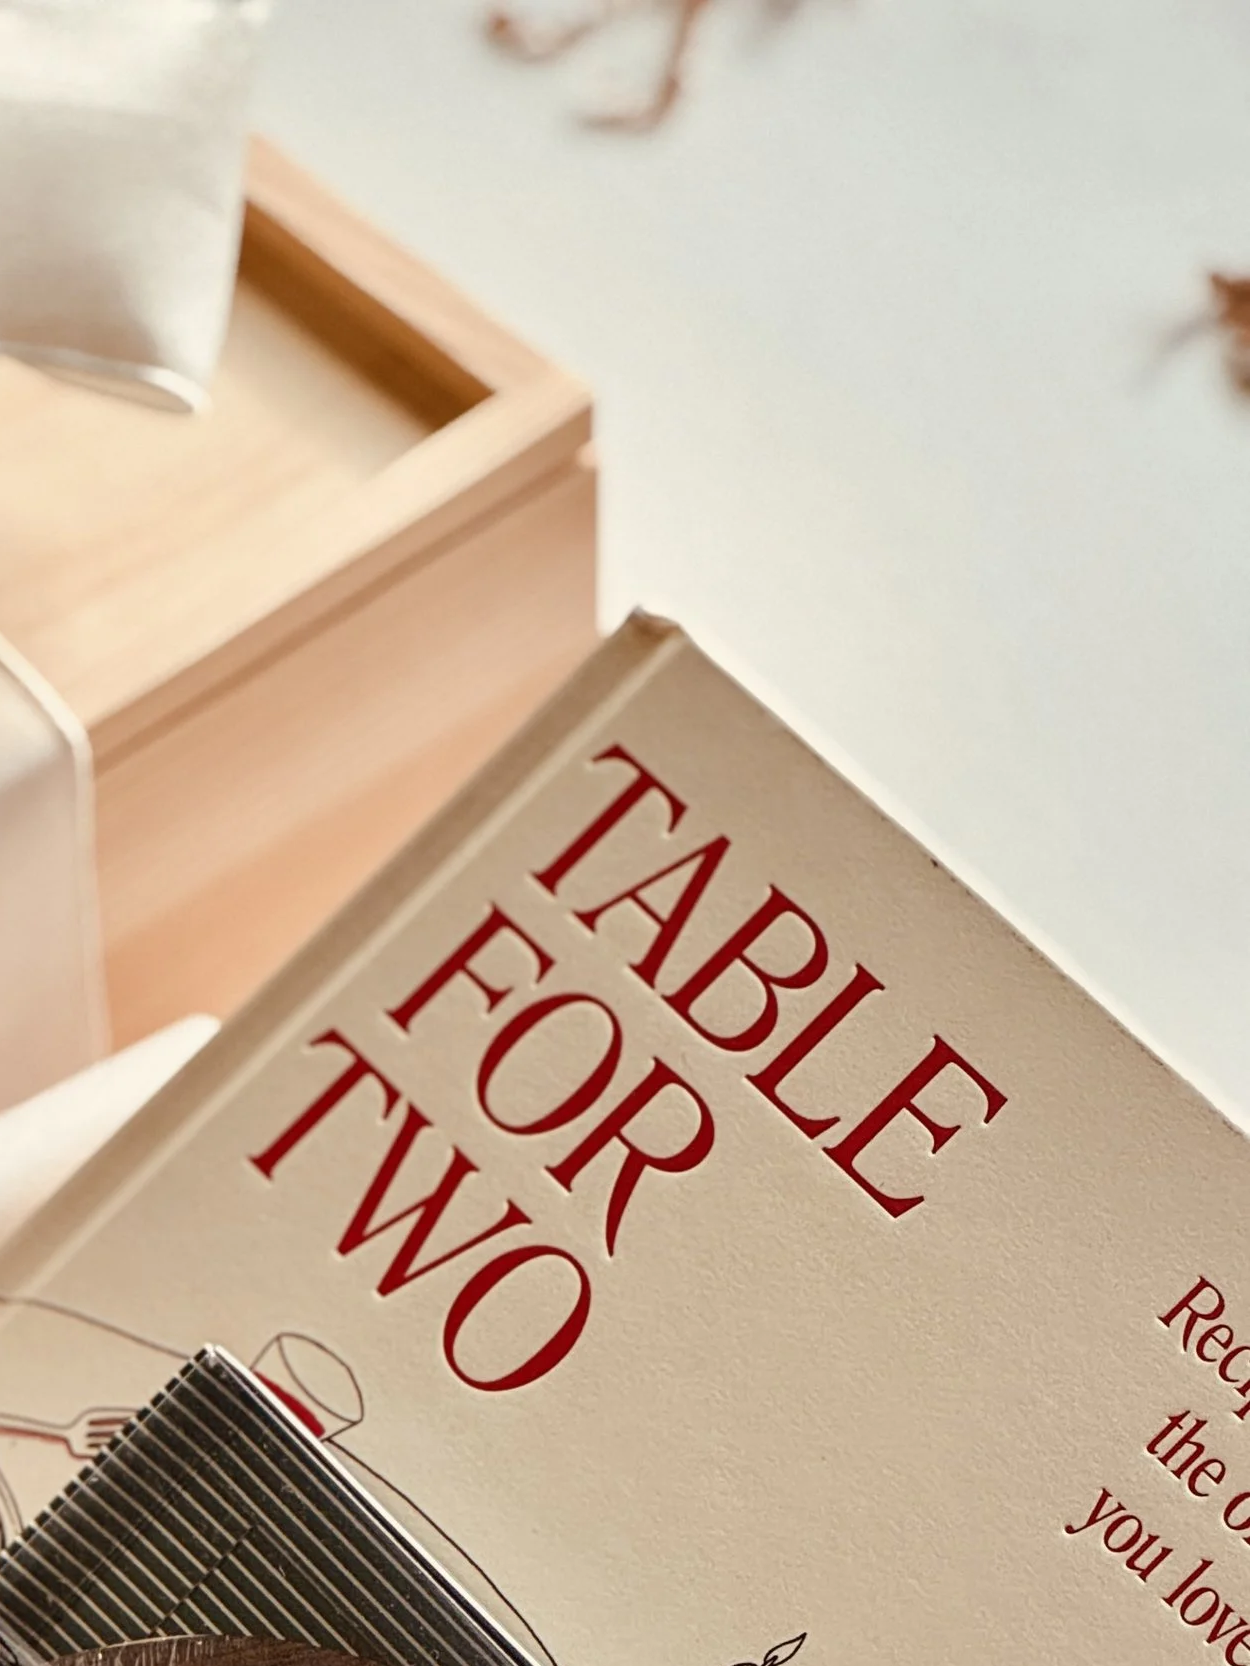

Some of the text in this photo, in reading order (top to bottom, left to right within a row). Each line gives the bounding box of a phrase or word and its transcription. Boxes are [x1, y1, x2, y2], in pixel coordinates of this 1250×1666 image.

[384, 902, 716, 1258] FOR
[530, 744, 1008, 1218] TABLE
[248, 1028, 592, 1391] TWO
[1064, 1487, 1173, 1583] you
[1146, 1410, 1226, 1498] the
